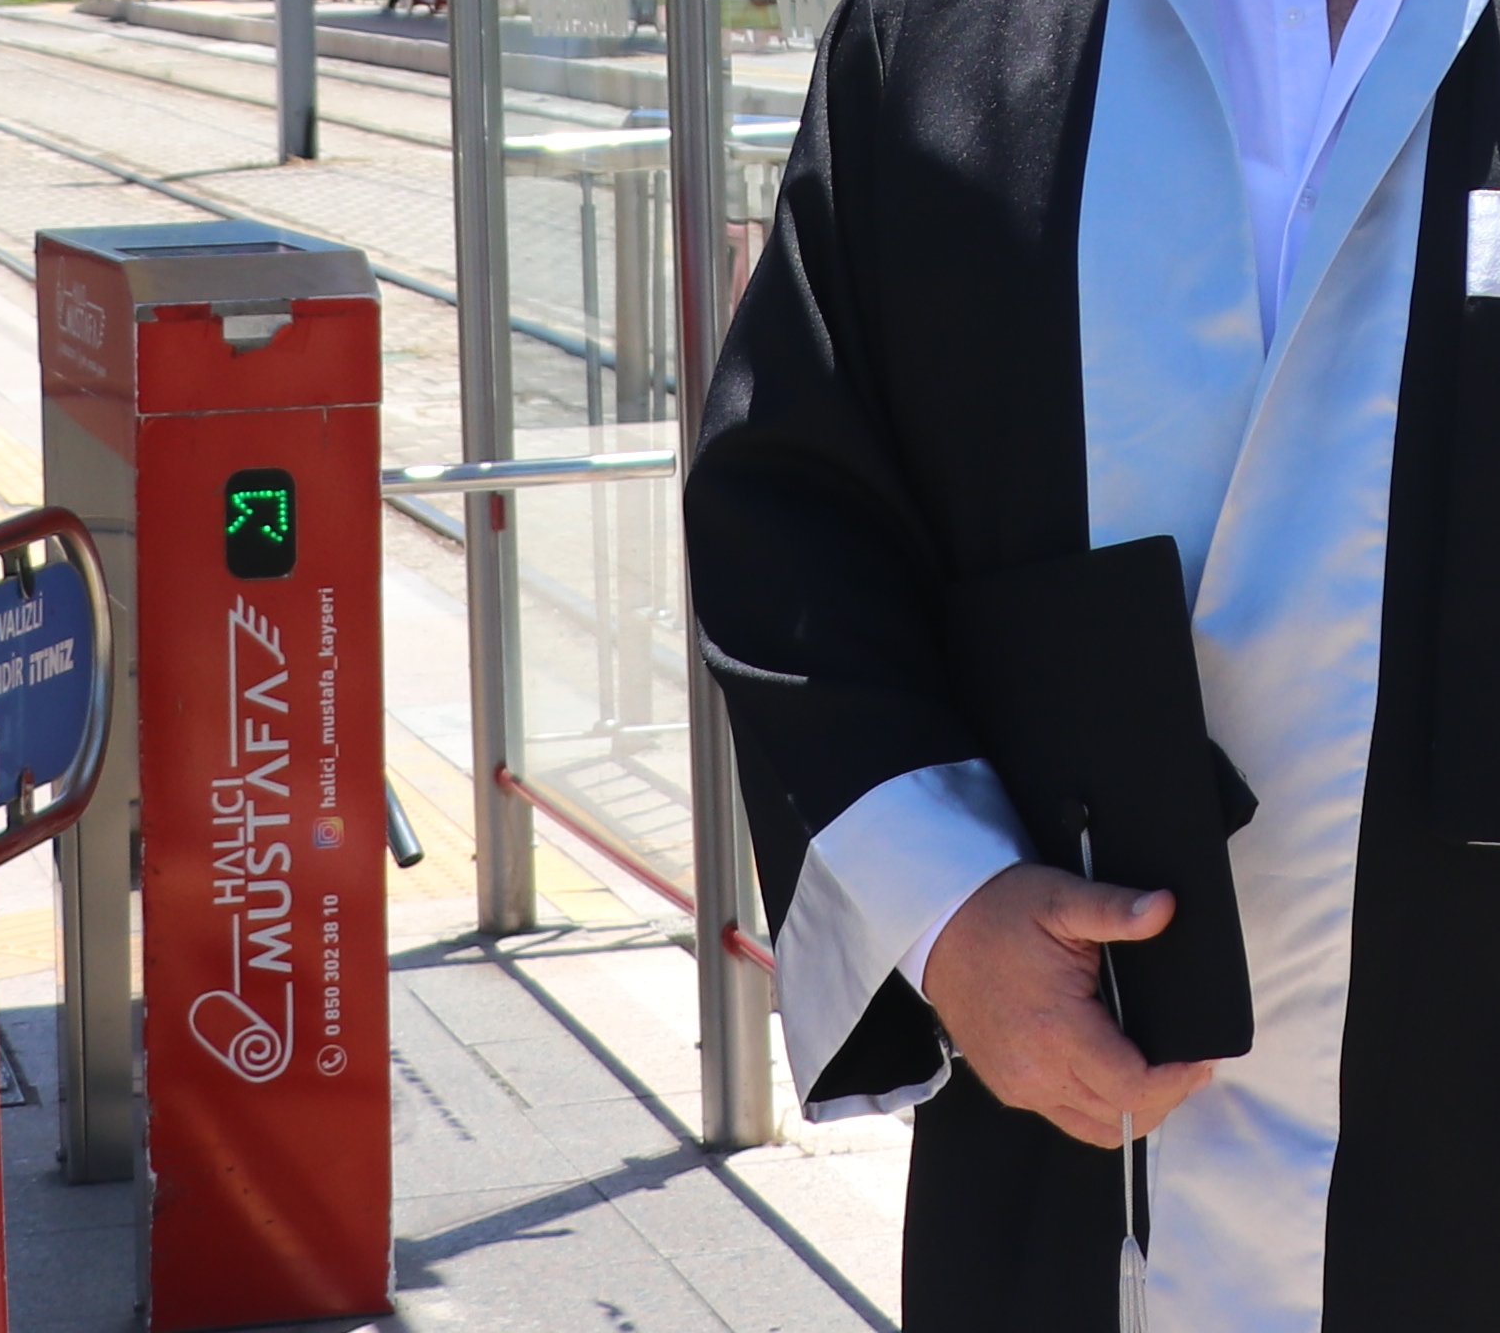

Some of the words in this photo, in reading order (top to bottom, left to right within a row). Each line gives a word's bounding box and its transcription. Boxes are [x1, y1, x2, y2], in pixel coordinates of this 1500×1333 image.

[317, 587, 340, 810] halici_mustafa_kayseri
[244, 670, 293, 974] MUSTAFA
[211, 777, 246, 906] HALICI
[323, 894, 339, 916] 10
[323, 921, 339, 944] 38
[324, 948, 340, 982] 302
[325, 986, 340, 1020] 850
[325, 1024, 341, 1036] 0
